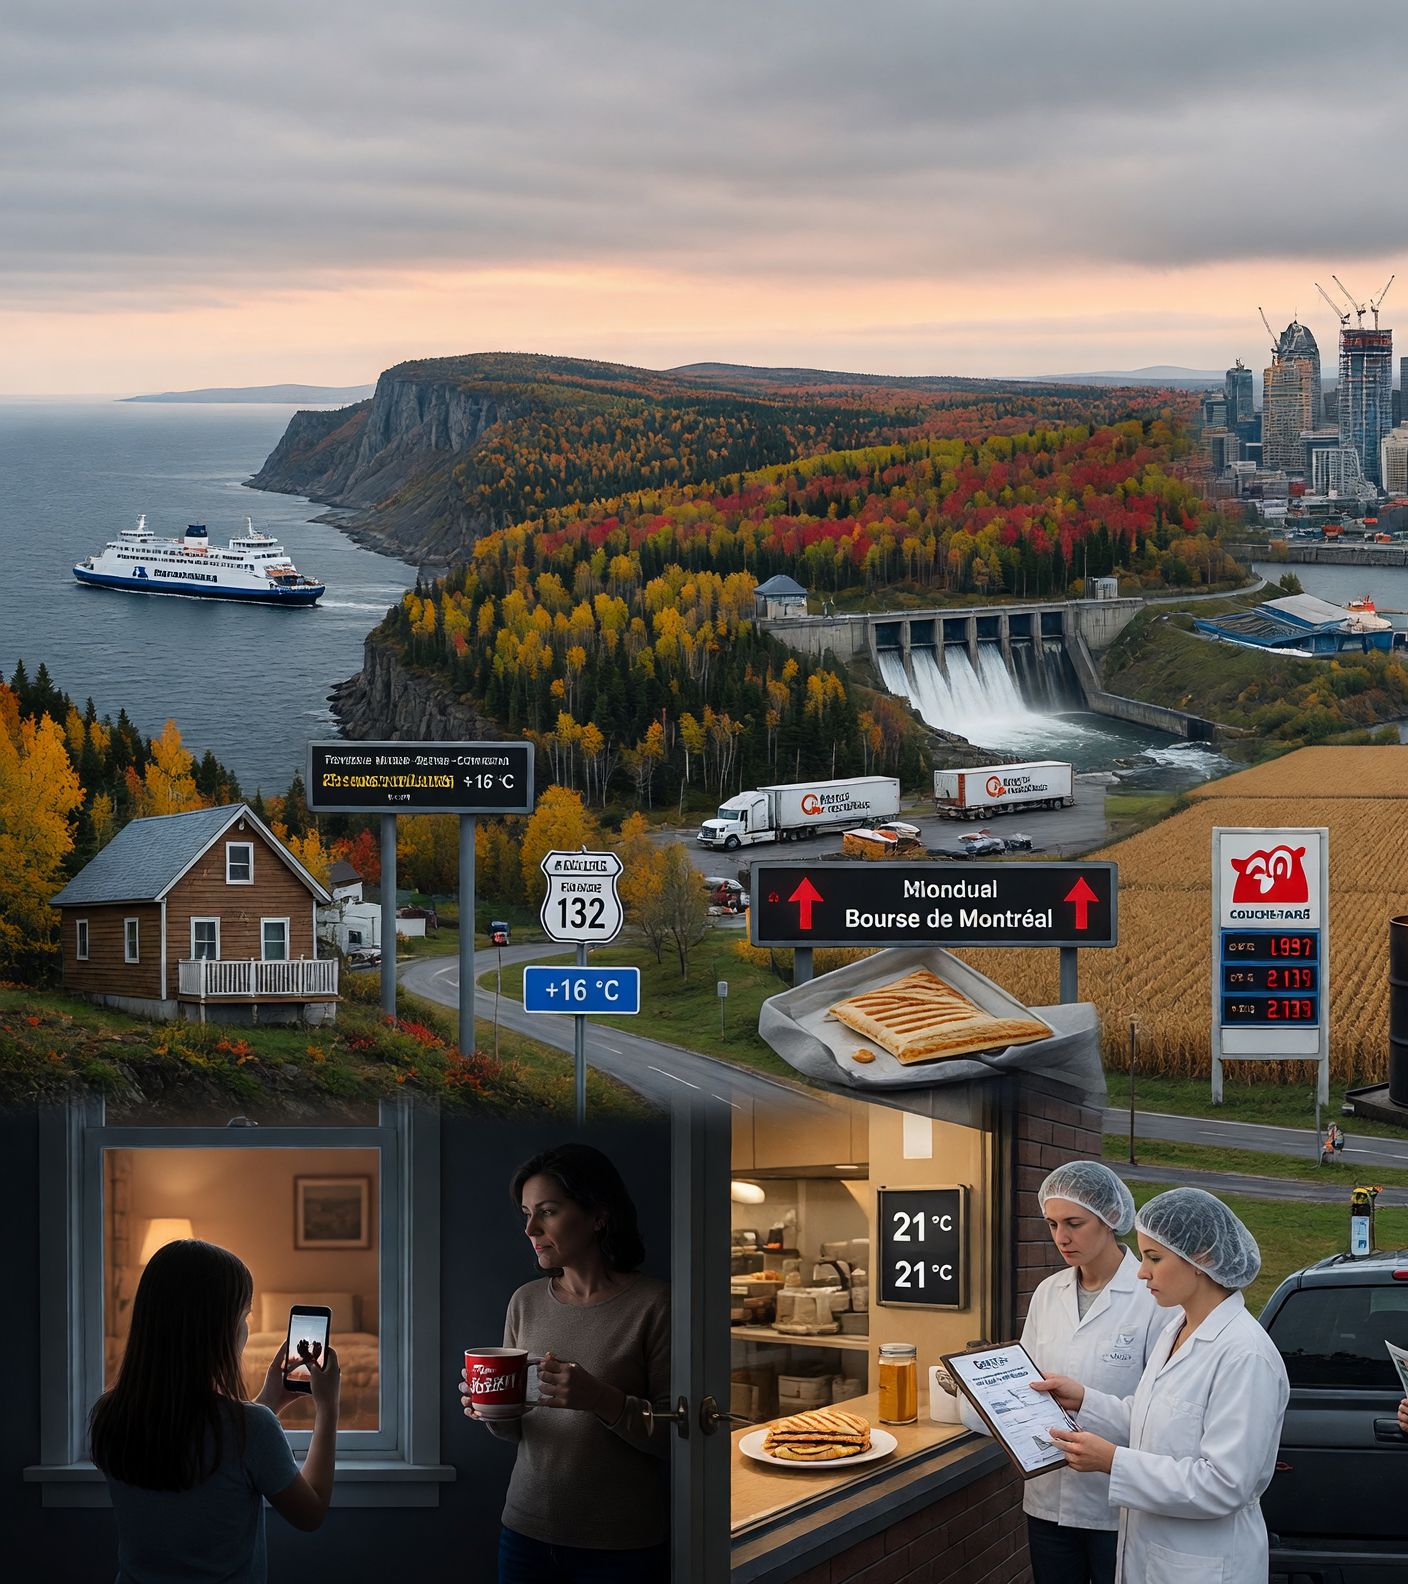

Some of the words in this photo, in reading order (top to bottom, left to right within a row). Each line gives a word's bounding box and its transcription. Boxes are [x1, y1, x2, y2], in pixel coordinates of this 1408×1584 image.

[463, 774, 493, 789] +16
[557, 897, 606, 929] 132
[845, 909, 920, 928] Bourse
[927, 908, 953, 928] de
[959, 908, 1053, 928] Montréal
[545, 979, 587, 1001] +16
[596, 980, 619, 1001] °C
[893, 1211, 925, 1242] 21
[931, 1215, 952, 1232] °C
[894, 1260, 925, 1288] 21
[931, 1264, 952, 1280] °C
